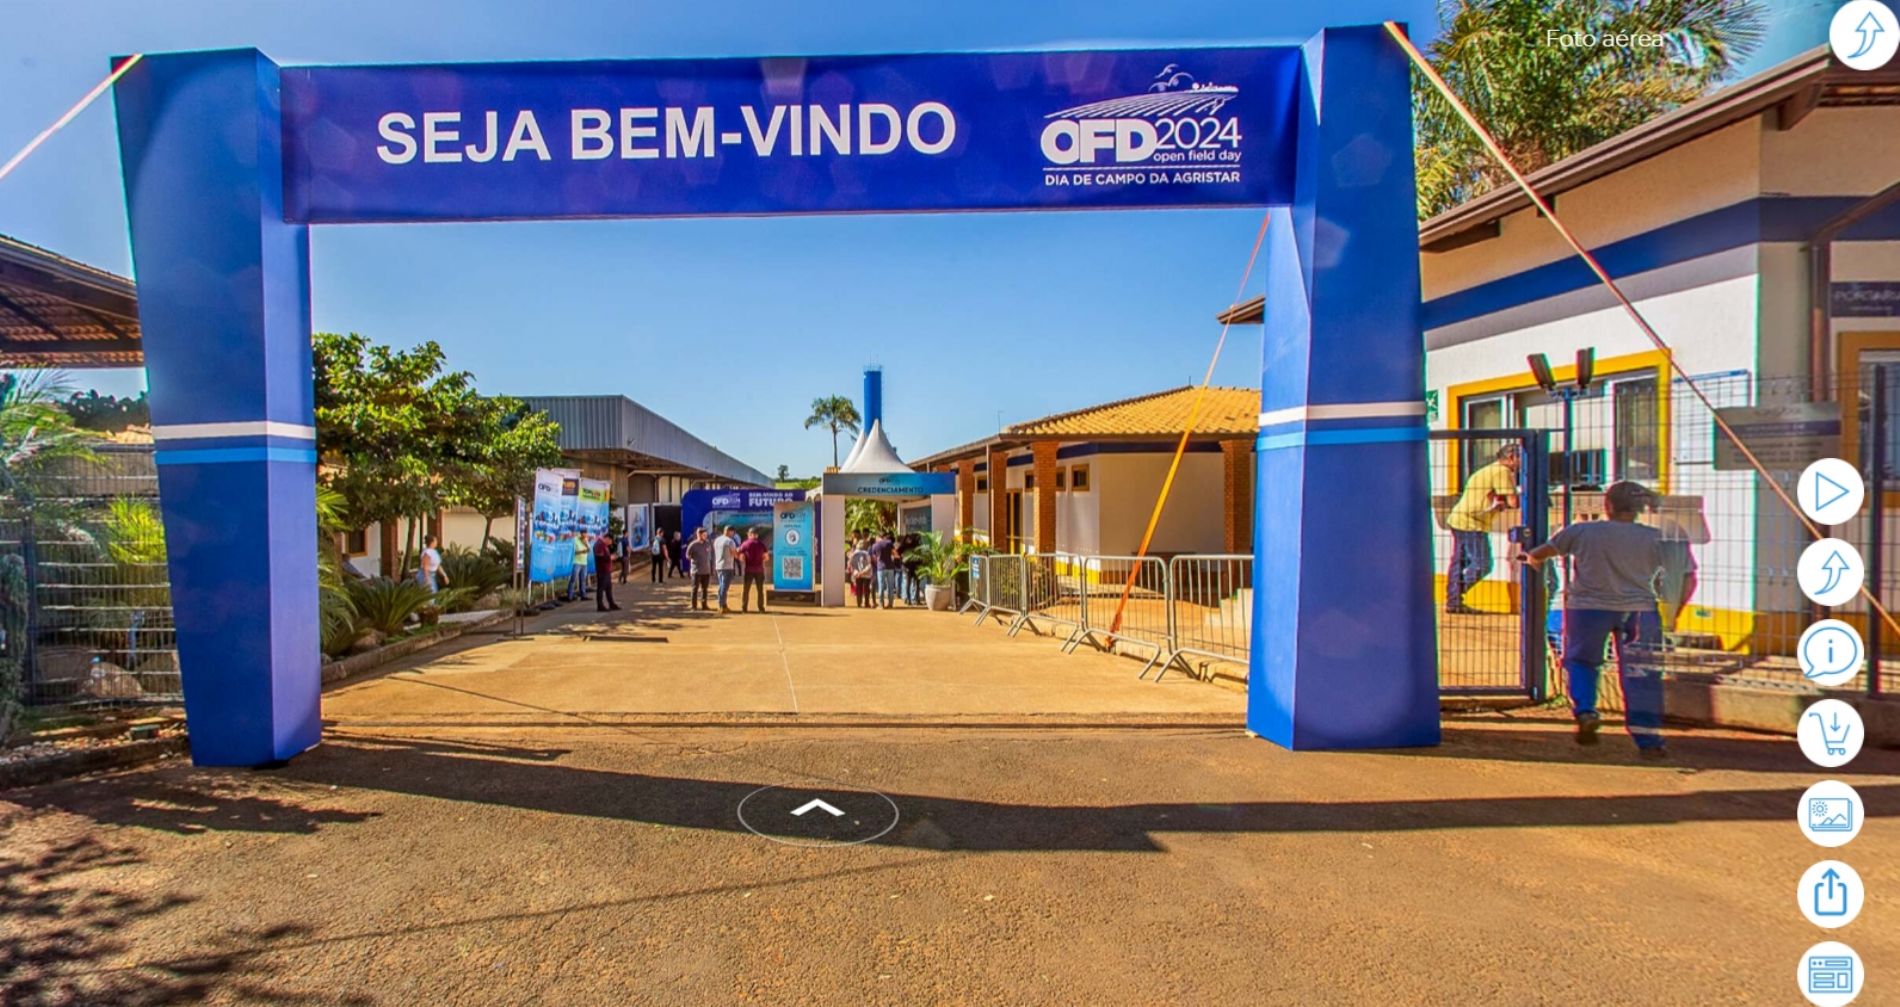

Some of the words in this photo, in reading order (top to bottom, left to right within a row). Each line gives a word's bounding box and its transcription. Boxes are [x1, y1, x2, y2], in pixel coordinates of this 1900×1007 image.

[376, 110, 552, 164] SEJA
[571, 101, 957, 160] BEM-VINDO
[1041, 119, 1157, 164] OFD
[1155, 117, 1242, 150] 2024
[1153, 151, 1185, 162] open
[1188, 149, 1216, 161] field
[1219, 149, 1242, 162] day
[1045, 174, 1069, 186] DIA
[1073, 173, 1092, 185] DE
[1096, 173, 1146, 185] CAMPO
[1150, 172, 1169, 184] DA
[1173, 171, 1241, 184] AGRISTAR
[857, 486, 924, 494] CREDENCIAMENTO
